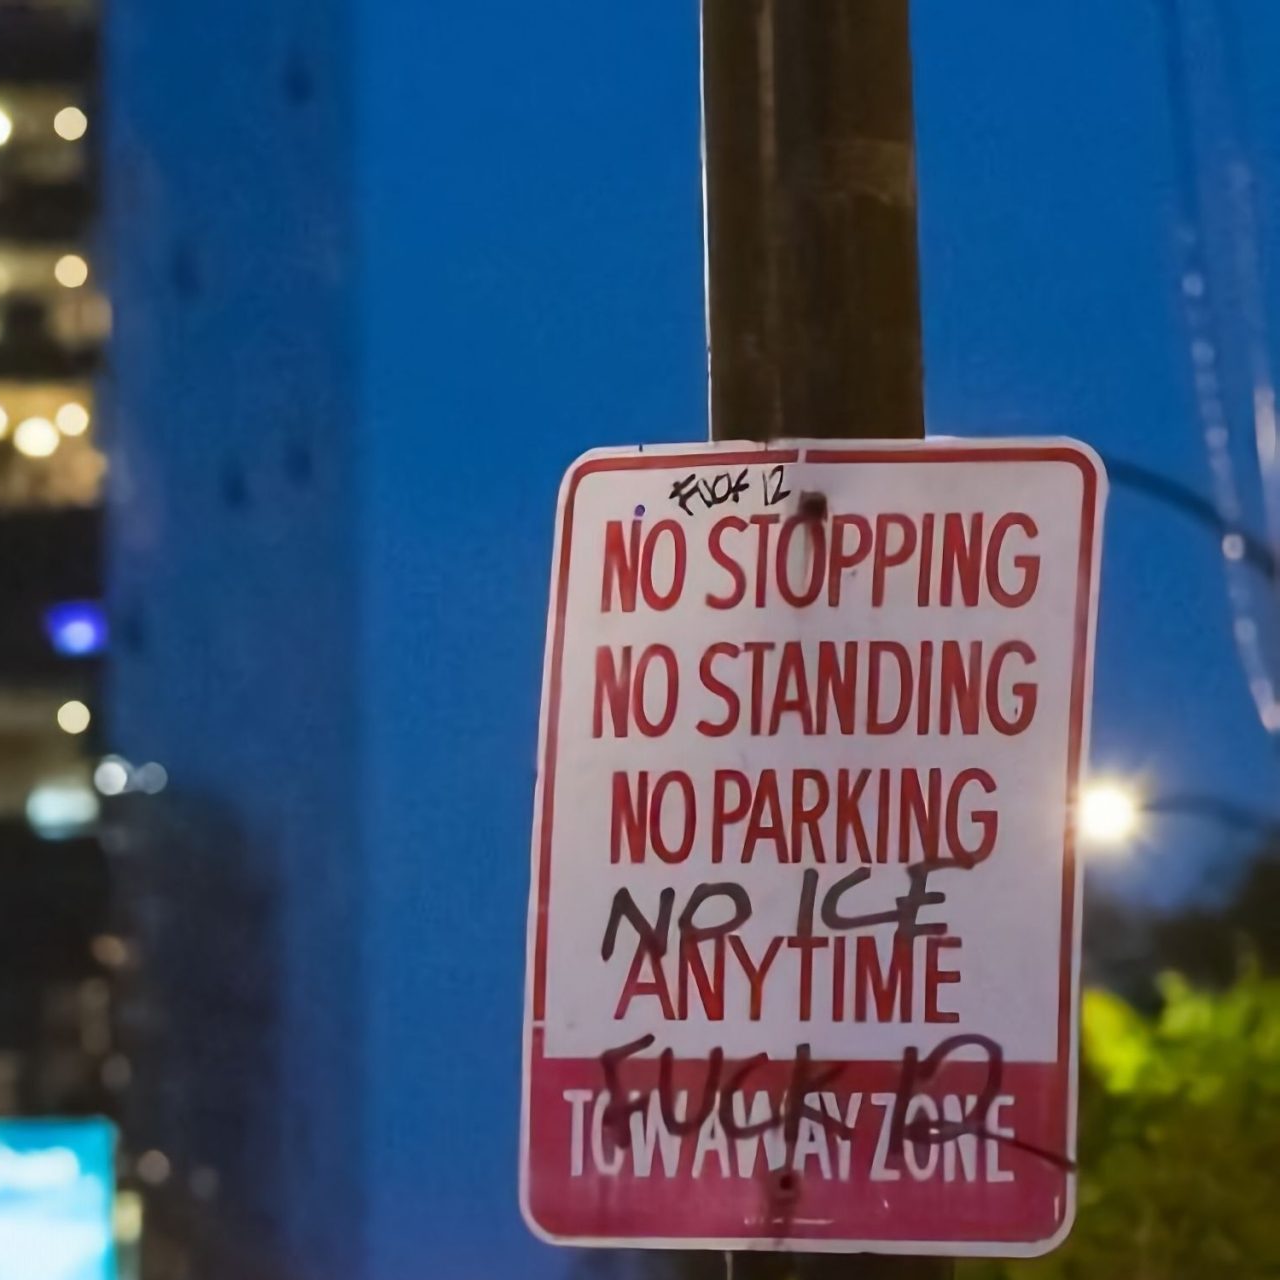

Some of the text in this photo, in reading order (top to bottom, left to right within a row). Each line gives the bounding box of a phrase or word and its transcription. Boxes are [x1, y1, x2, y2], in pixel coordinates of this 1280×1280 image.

[600, 511, 1041, 613] NO STOPPING
[592, 640, 1039, 738] NO STANDING
[610, 767, 999, 865] NO PARKING
[600, 857, 974, 961] NO ICE
[613, 934, 963, 1023] ANYTIME
[600, 1033, 856, 1150] FUCK
[870, 1093, 1016, 1183] ZONE
